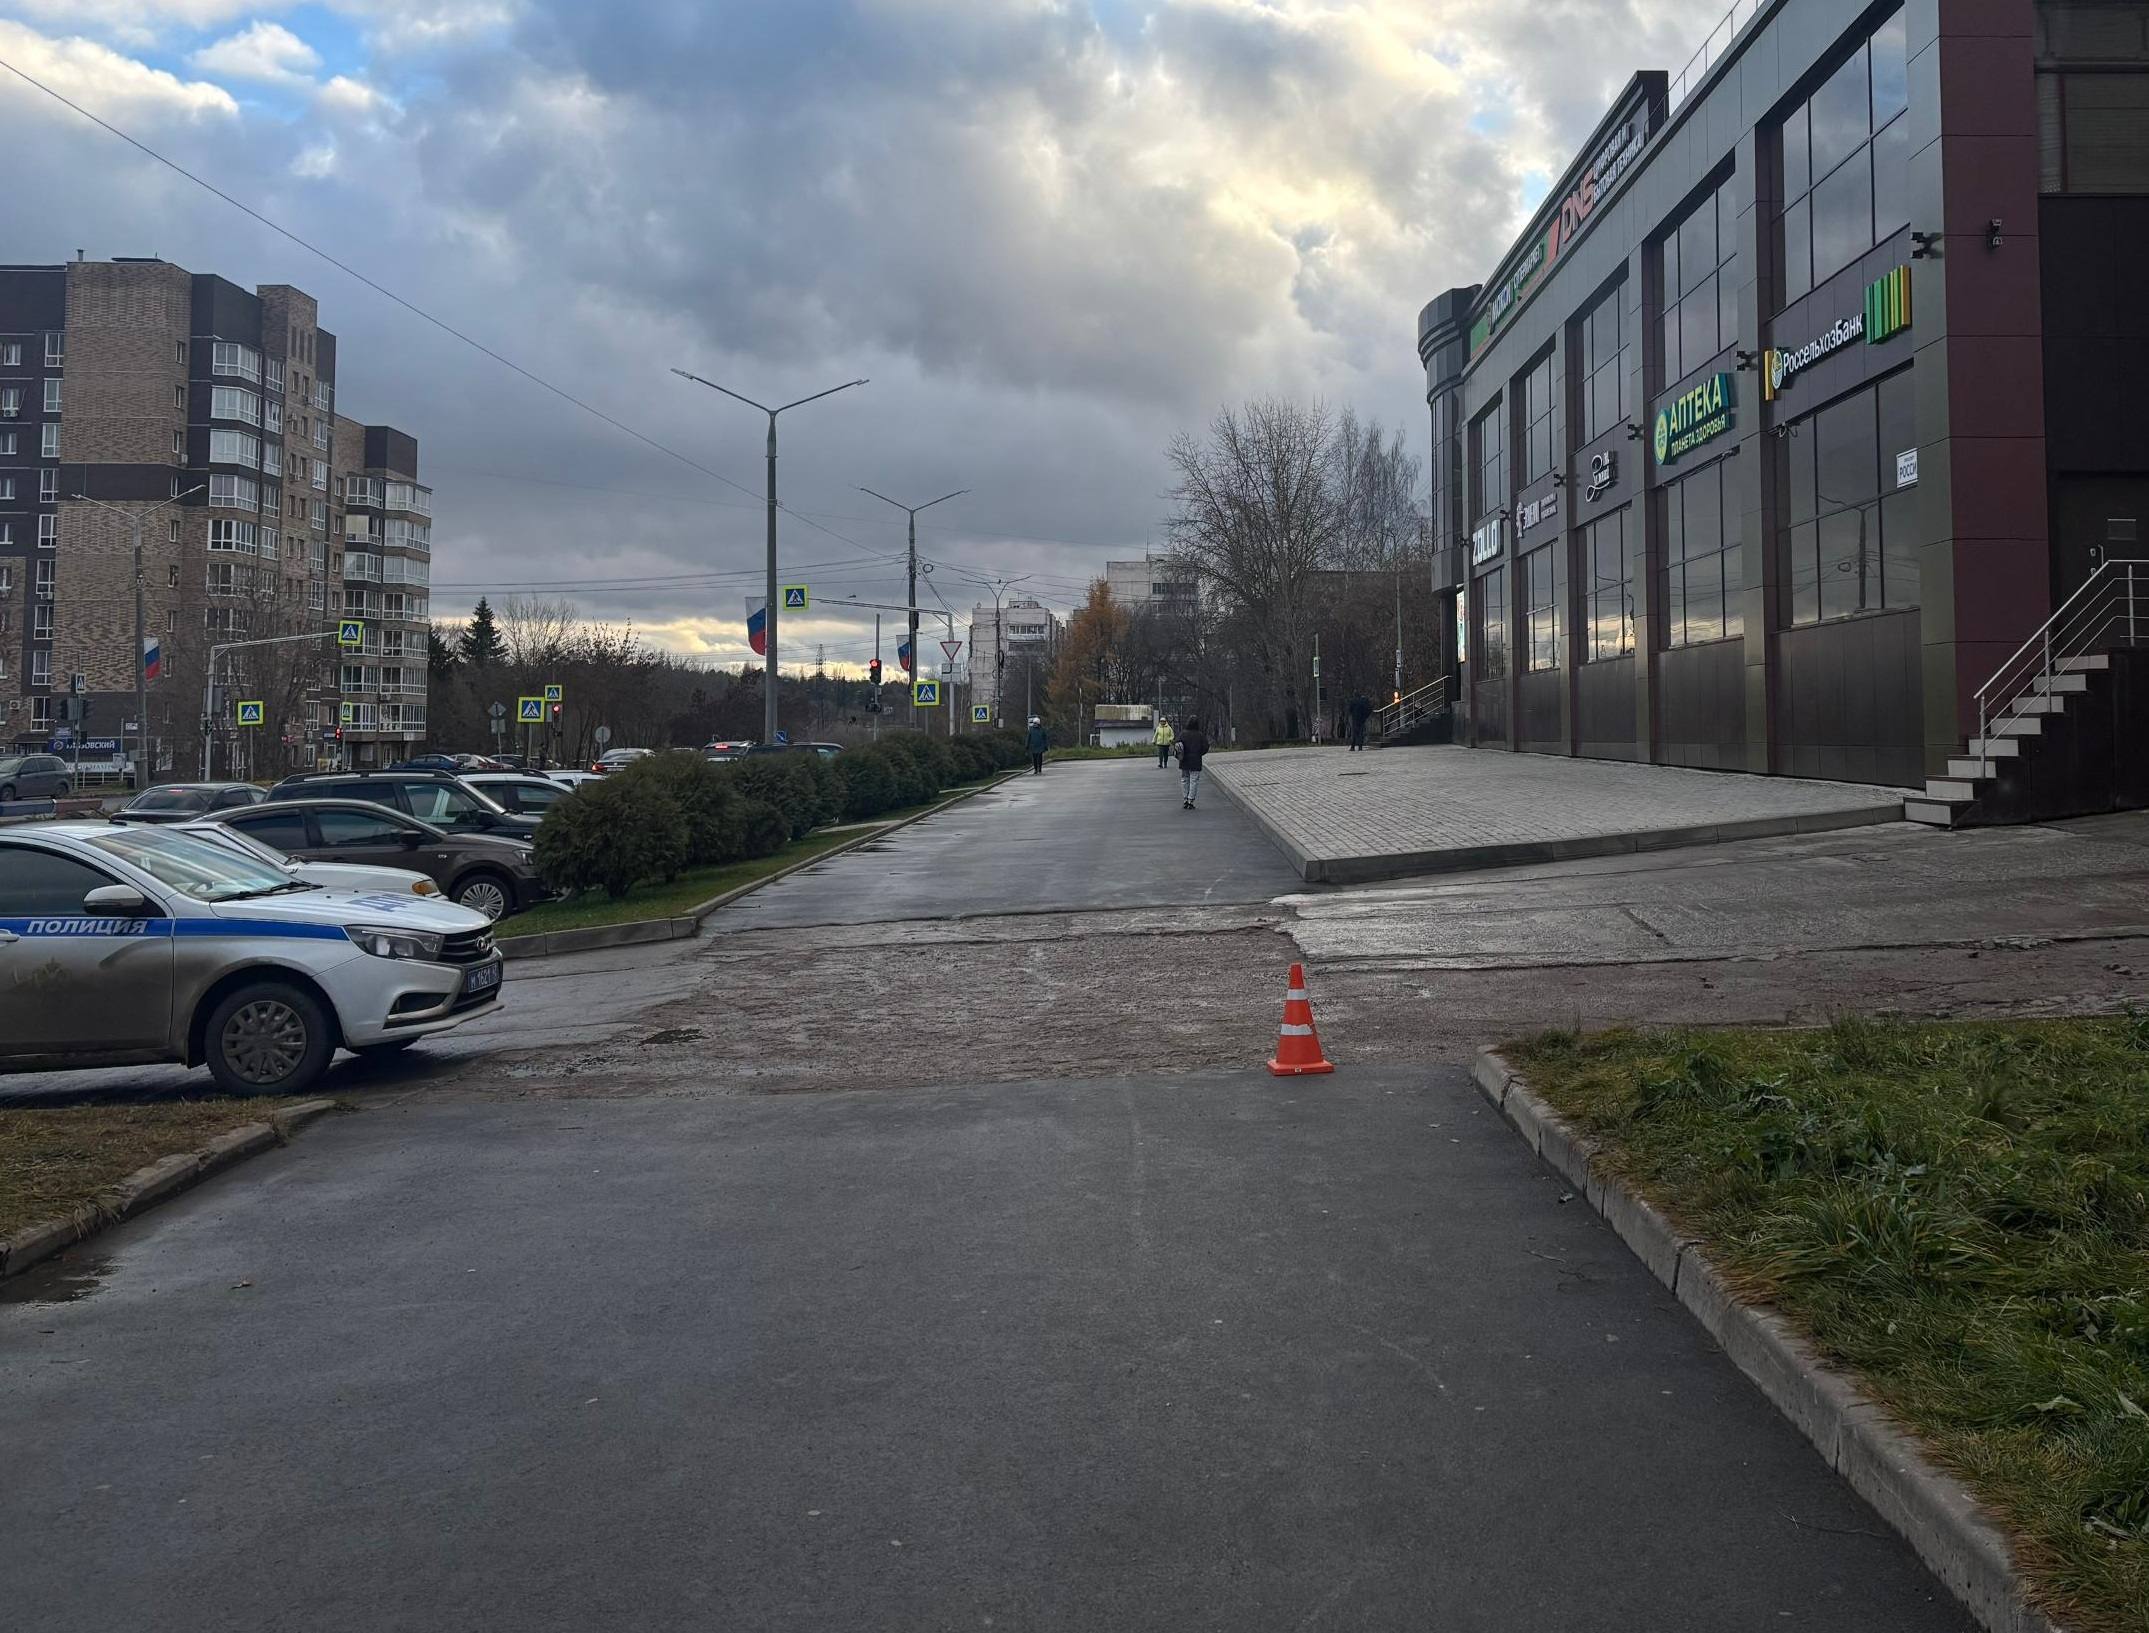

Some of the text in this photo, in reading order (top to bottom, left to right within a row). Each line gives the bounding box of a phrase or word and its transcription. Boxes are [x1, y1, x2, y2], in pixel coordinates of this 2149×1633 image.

[1560, 168, 1595, 242] DNS
[1783, 313, 1863, 376] РоссельхозБанк
[1669, 373, 1722, 437] АПТЕКА
[1671, 414, 1726, 457] ПЛАНЕТА ЗДОРОВЬЯ
[1473, 519, 1499, 566] ZOLLO
[27, 920, 148, 934] ПОЛИЦИЯ
